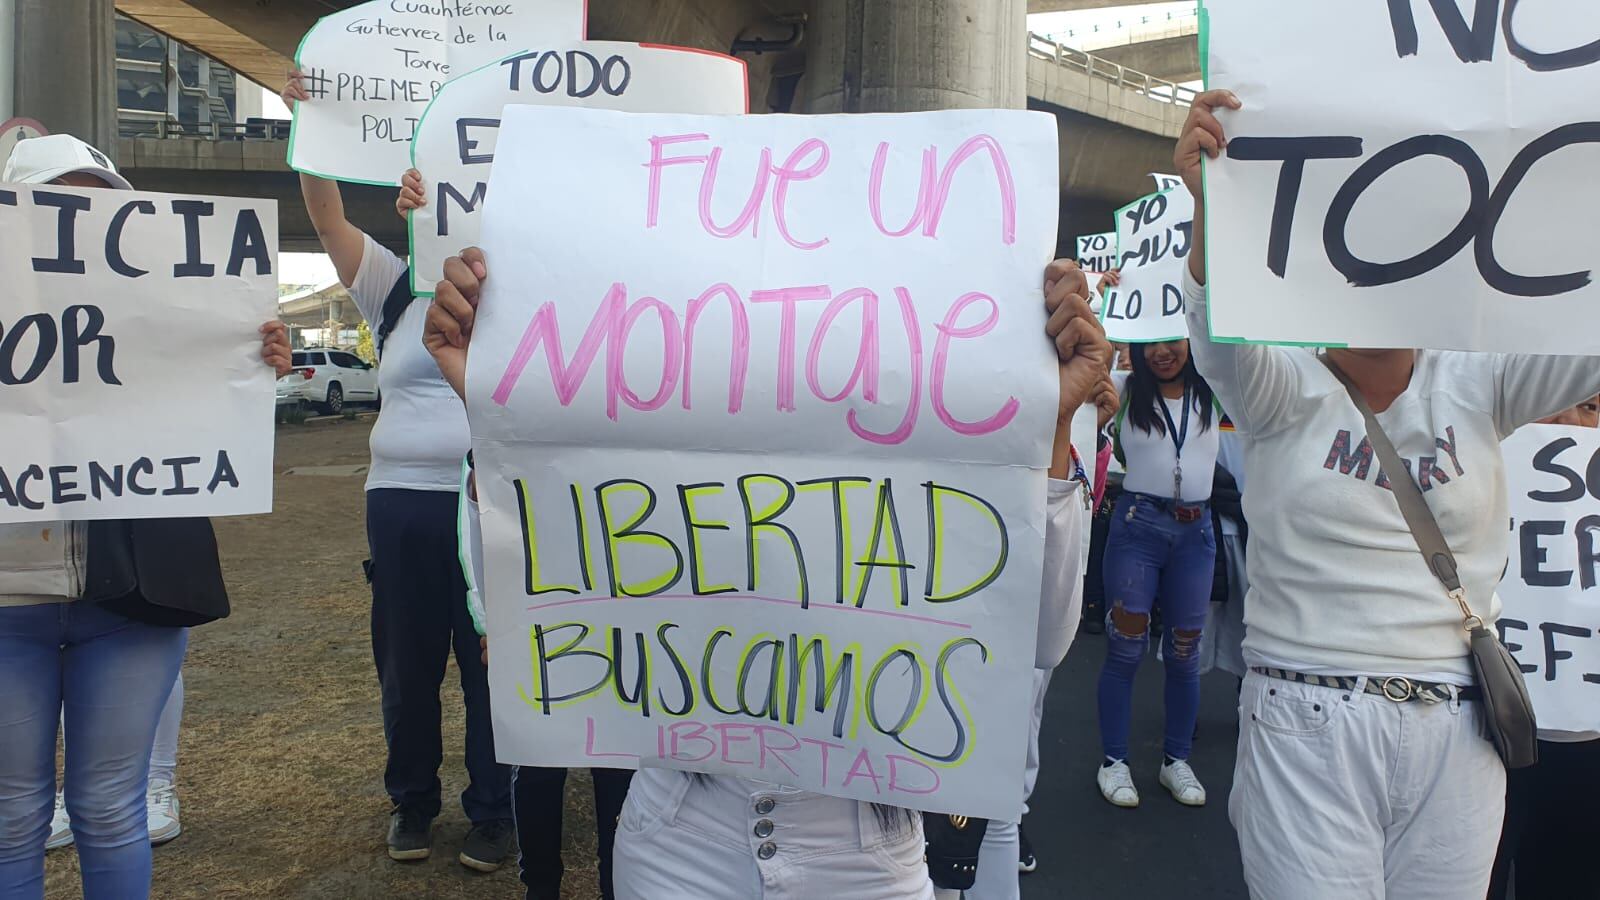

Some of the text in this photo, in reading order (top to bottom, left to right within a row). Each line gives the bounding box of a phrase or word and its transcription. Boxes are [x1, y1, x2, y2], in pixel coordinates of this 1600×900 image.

[454, 26, 476, 44] de
[488, 24, 507, 42] la
[394, 48, 450, 74] Torre
[501, 50, 631, 97] TODO
[641, 133, 1016, 249] Fue un
[1126, 194, 1167, 234] YO
[1079, 235, 1108, 252] YO
[1079, 255, 1116, 273] MU
[1106, 289, 1142, 320] LO
[0, 304, 123, 386] OR
[1527, 437, 1600, 503] S
[513, 473, 1009, 609] LIBERTAD
[585, 717, 940, 794] LIBERTAD
